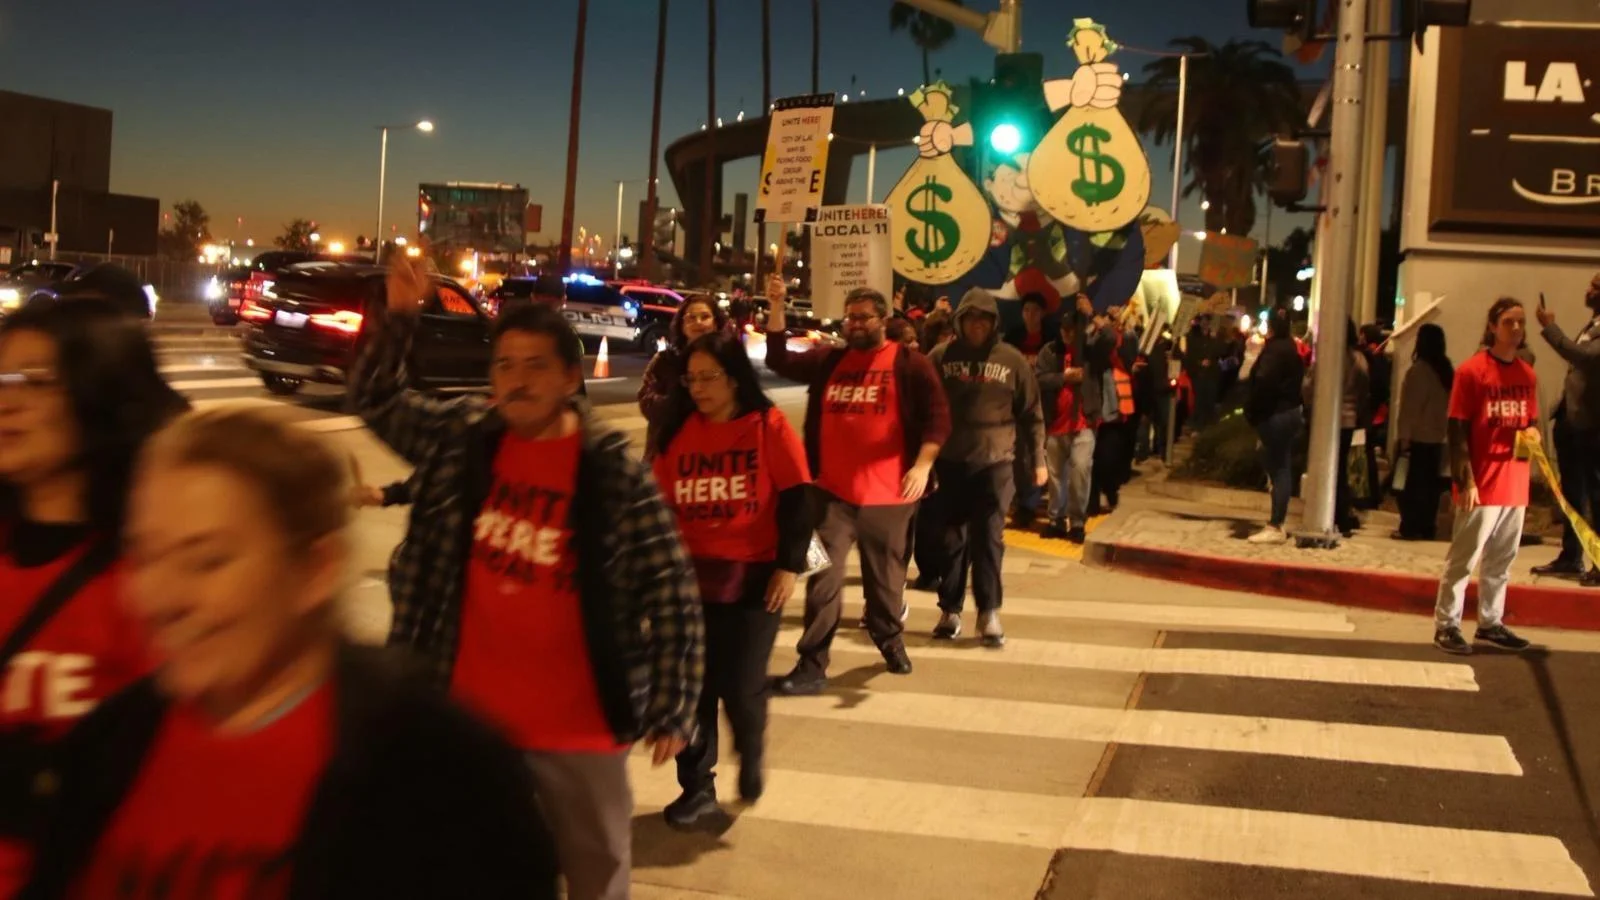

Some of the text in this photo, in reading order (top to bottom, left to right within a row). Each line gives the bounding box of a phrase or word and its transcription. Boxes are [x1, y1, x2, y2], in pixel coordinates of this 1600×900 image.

[815, 222, 888, 237] LOCAL 11
[942, 361, 1011, 384] NEW YORK
[677, 448, 759, 478] UNITE
